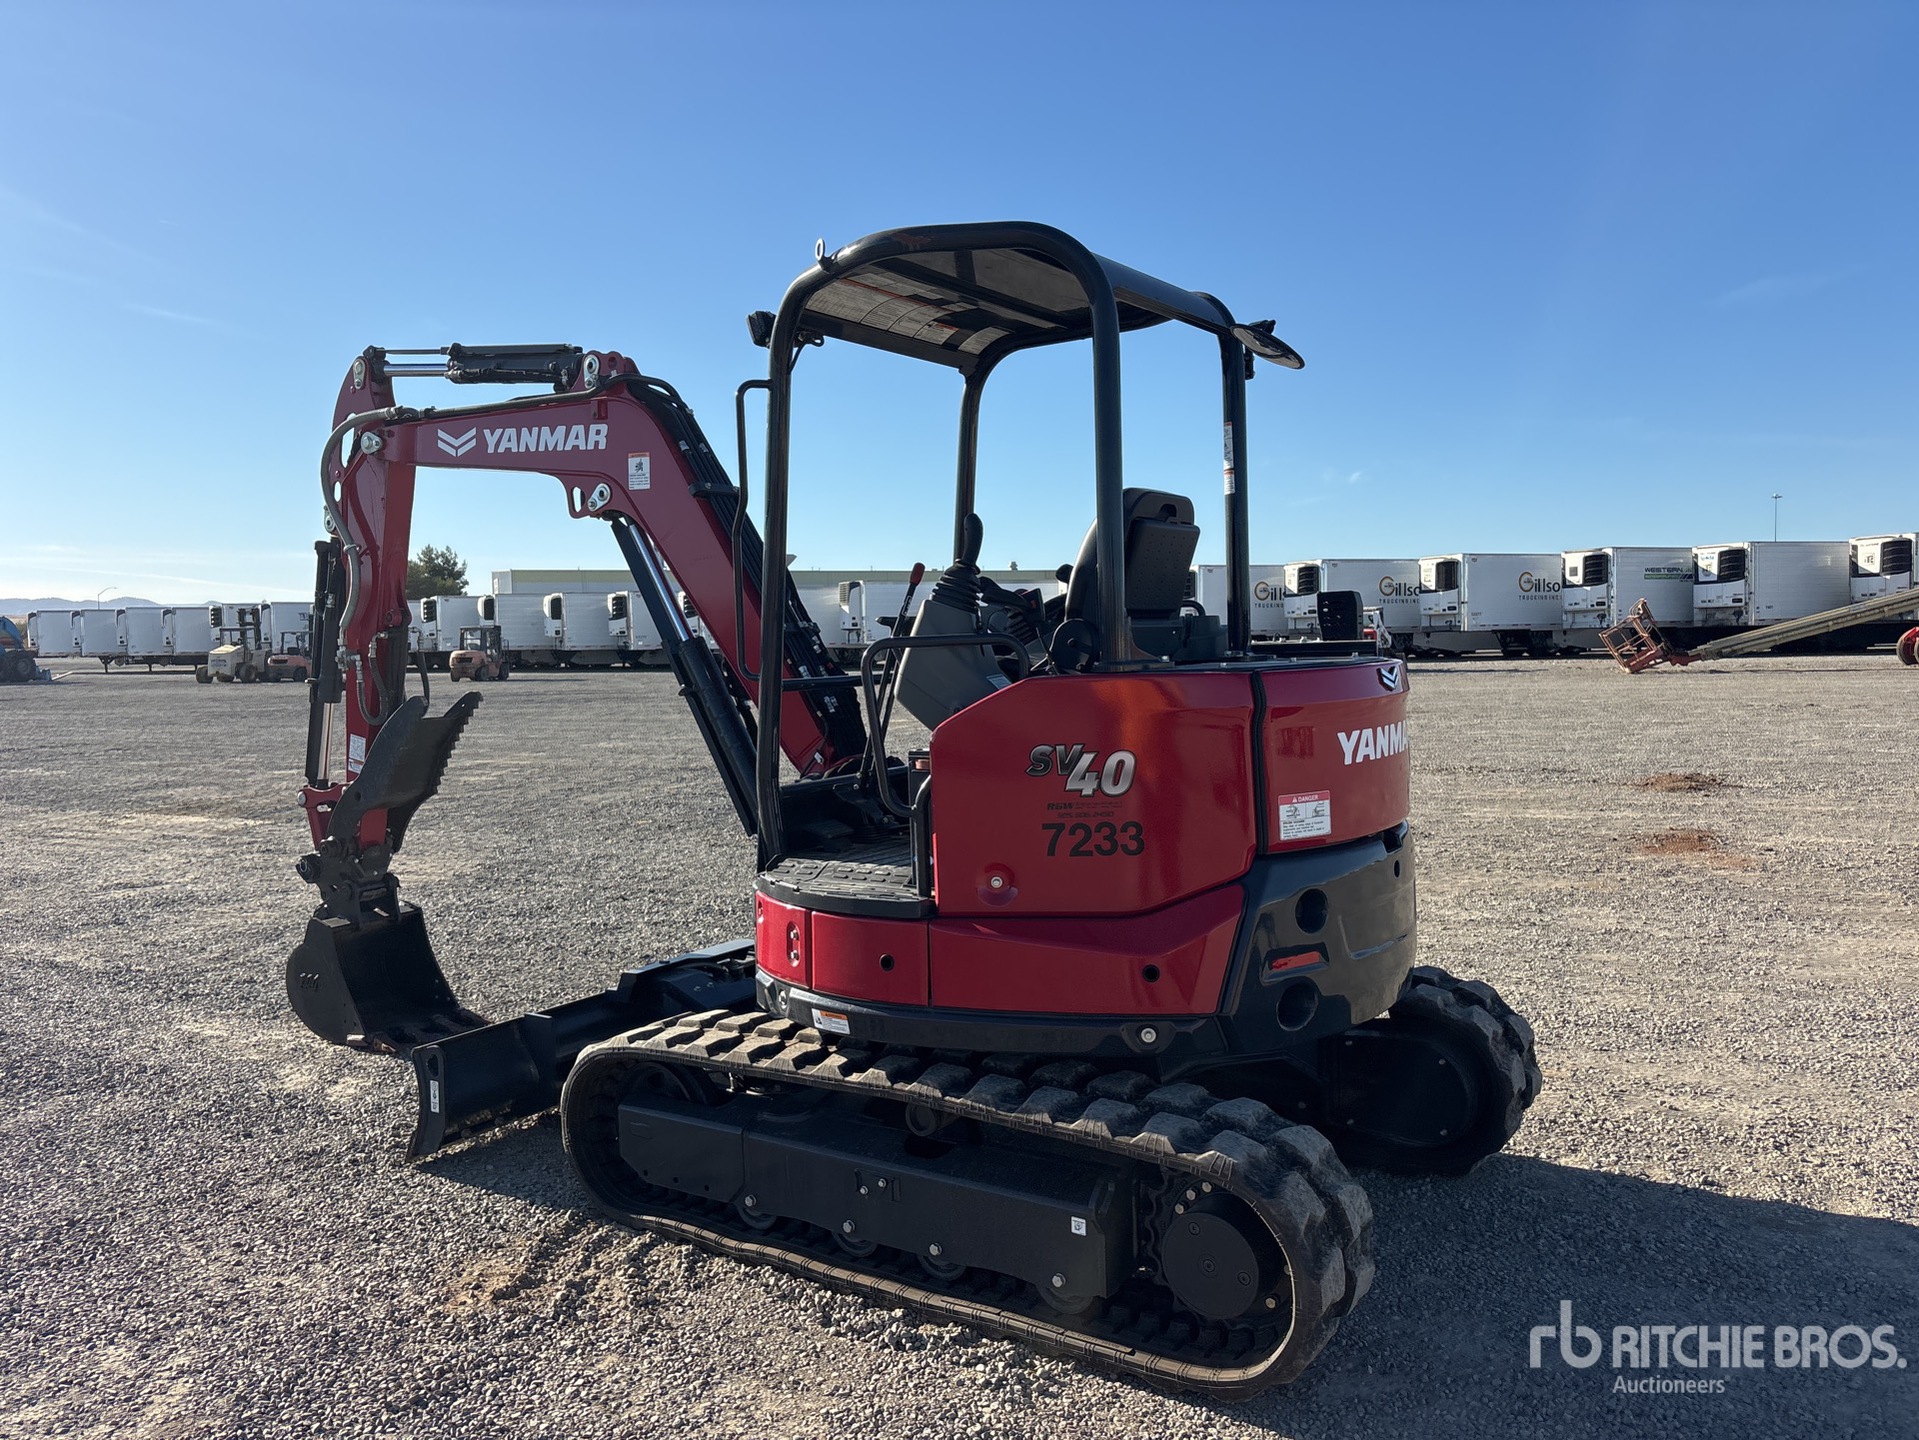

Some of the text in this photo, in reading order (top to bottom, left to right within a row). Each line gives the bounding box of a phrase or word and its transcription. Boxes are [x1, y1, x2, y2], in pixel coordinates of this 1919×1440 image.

[483, 423, 608, 454] YANMAR
[1254, 581, 1284, 601] Gill
[1379, 576, 1420, 597] Gillso
[1518, 571, 1561, 593] Gillso
[1337, 720, 1409, 766] YANMA
[1041, 821, 1145, 857] 7233
